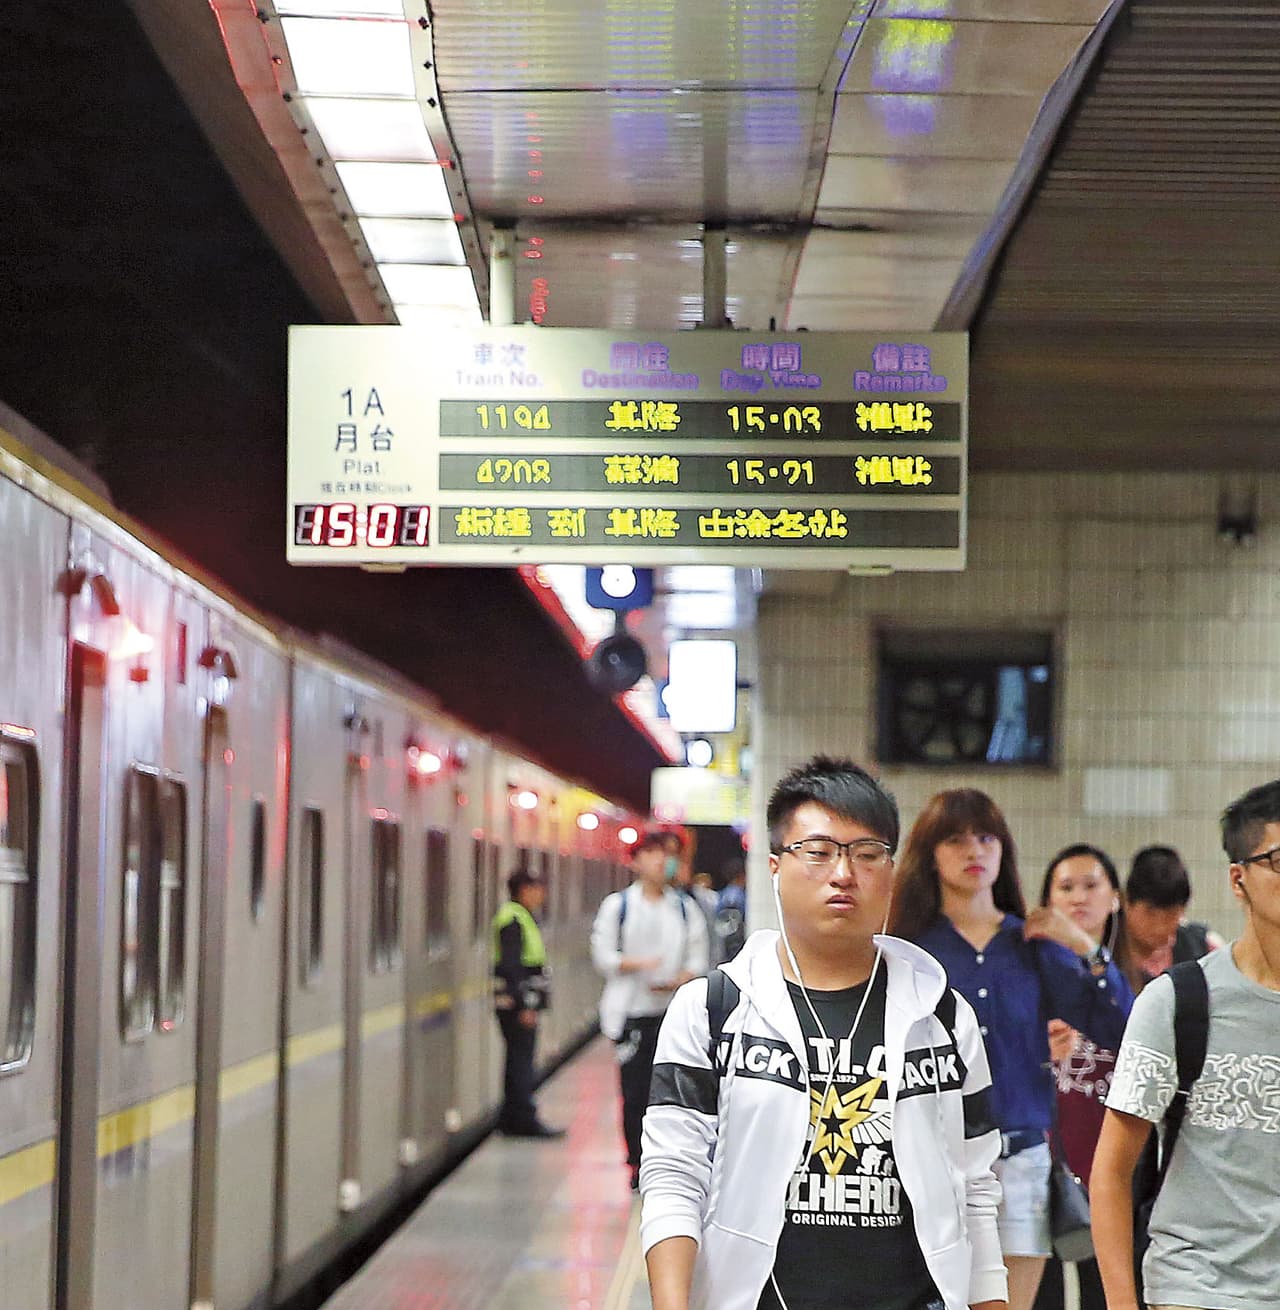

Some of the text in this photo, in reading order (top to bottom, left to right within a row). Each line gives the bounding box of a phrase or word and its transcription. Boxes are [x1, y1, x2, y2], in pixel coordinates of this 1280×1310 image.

[741, 342, 802, 372] 時間
[456, 370, 504, 388] Train
[853, 369, 948, 392] Remarks
[335, 423, 395, 453] 月台
[310, 503, 431, 547] 15:01
[792, 1212, 857, 1228] ORIGINAL
